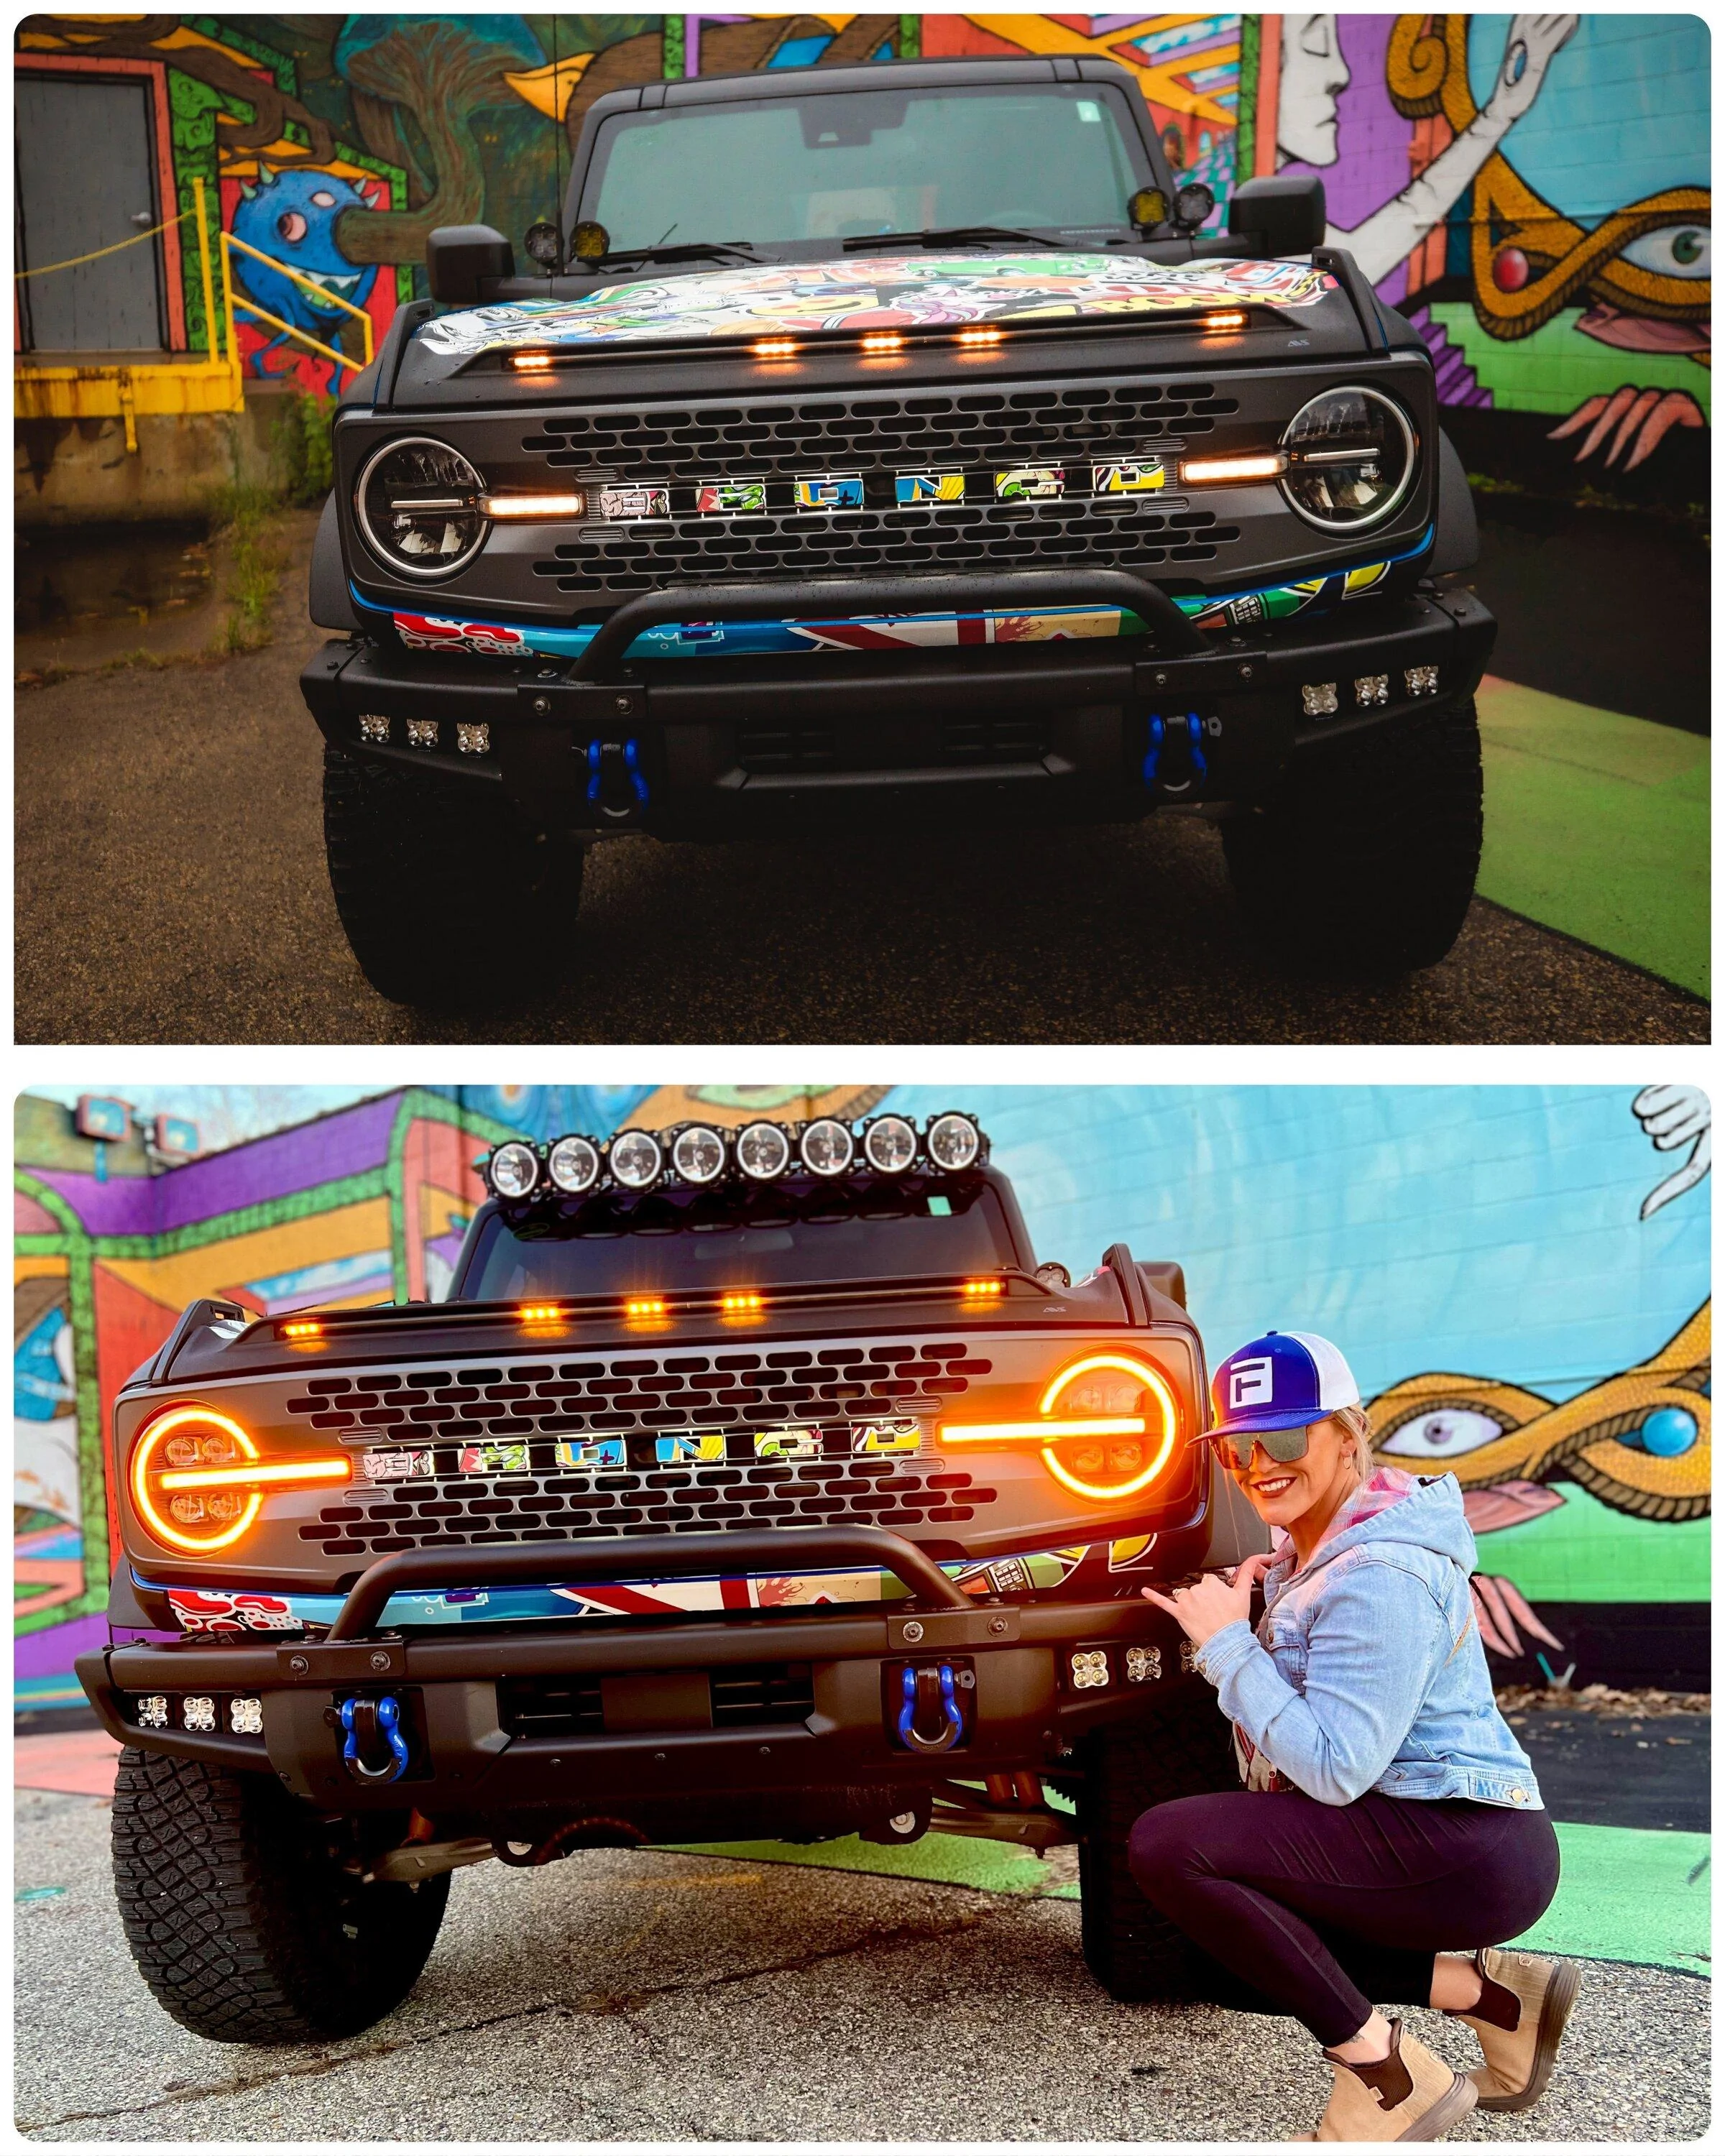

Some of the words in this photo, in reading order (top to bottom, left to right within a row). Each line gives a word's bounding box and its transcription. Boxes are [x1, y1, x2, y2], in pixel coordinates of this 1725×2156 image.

[1080, 292, 1293, 313] BOOM
[599, 461, 1165, 517] BRONCO
[362, 1423, 921, 1480] BRONCO
